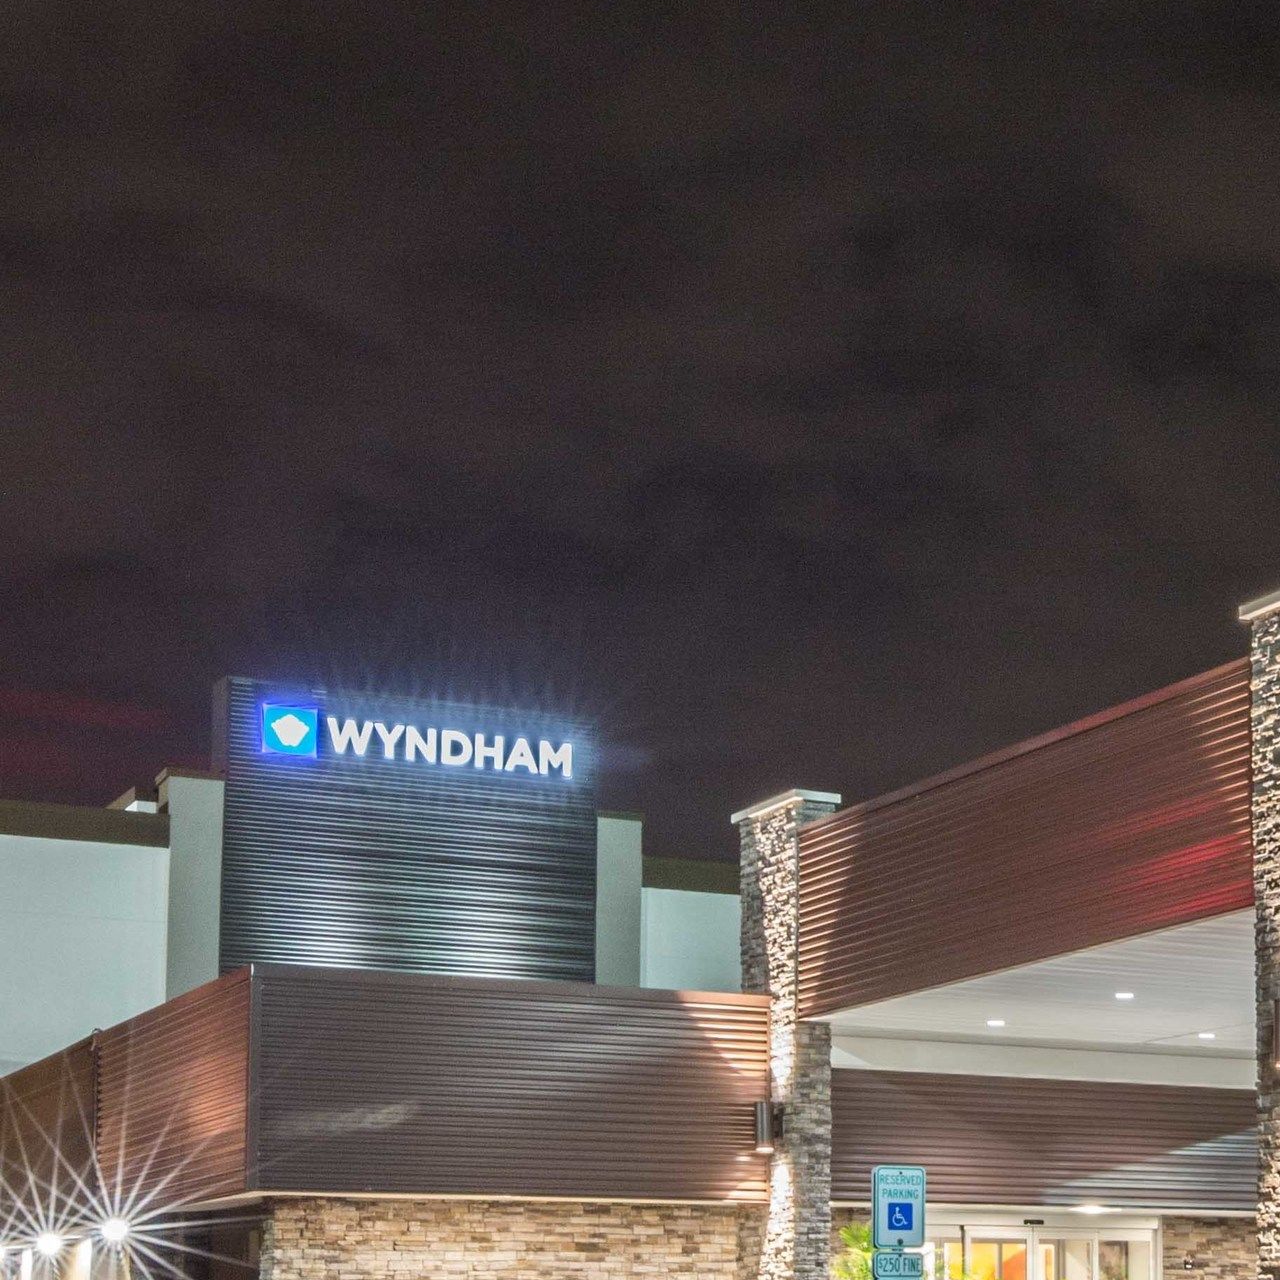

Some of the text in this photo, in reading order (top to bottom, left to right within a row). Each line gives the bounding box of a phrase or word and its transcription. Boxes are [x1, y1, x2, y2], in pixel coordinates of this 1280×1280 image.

[326, 717, 574, 778] WYNDHAM
[880, 1174, 922, 1186] RESERVED
[882, 1188, 920, 1200] PARKING
[878, 1257, 921, 1273] $250 FINE
